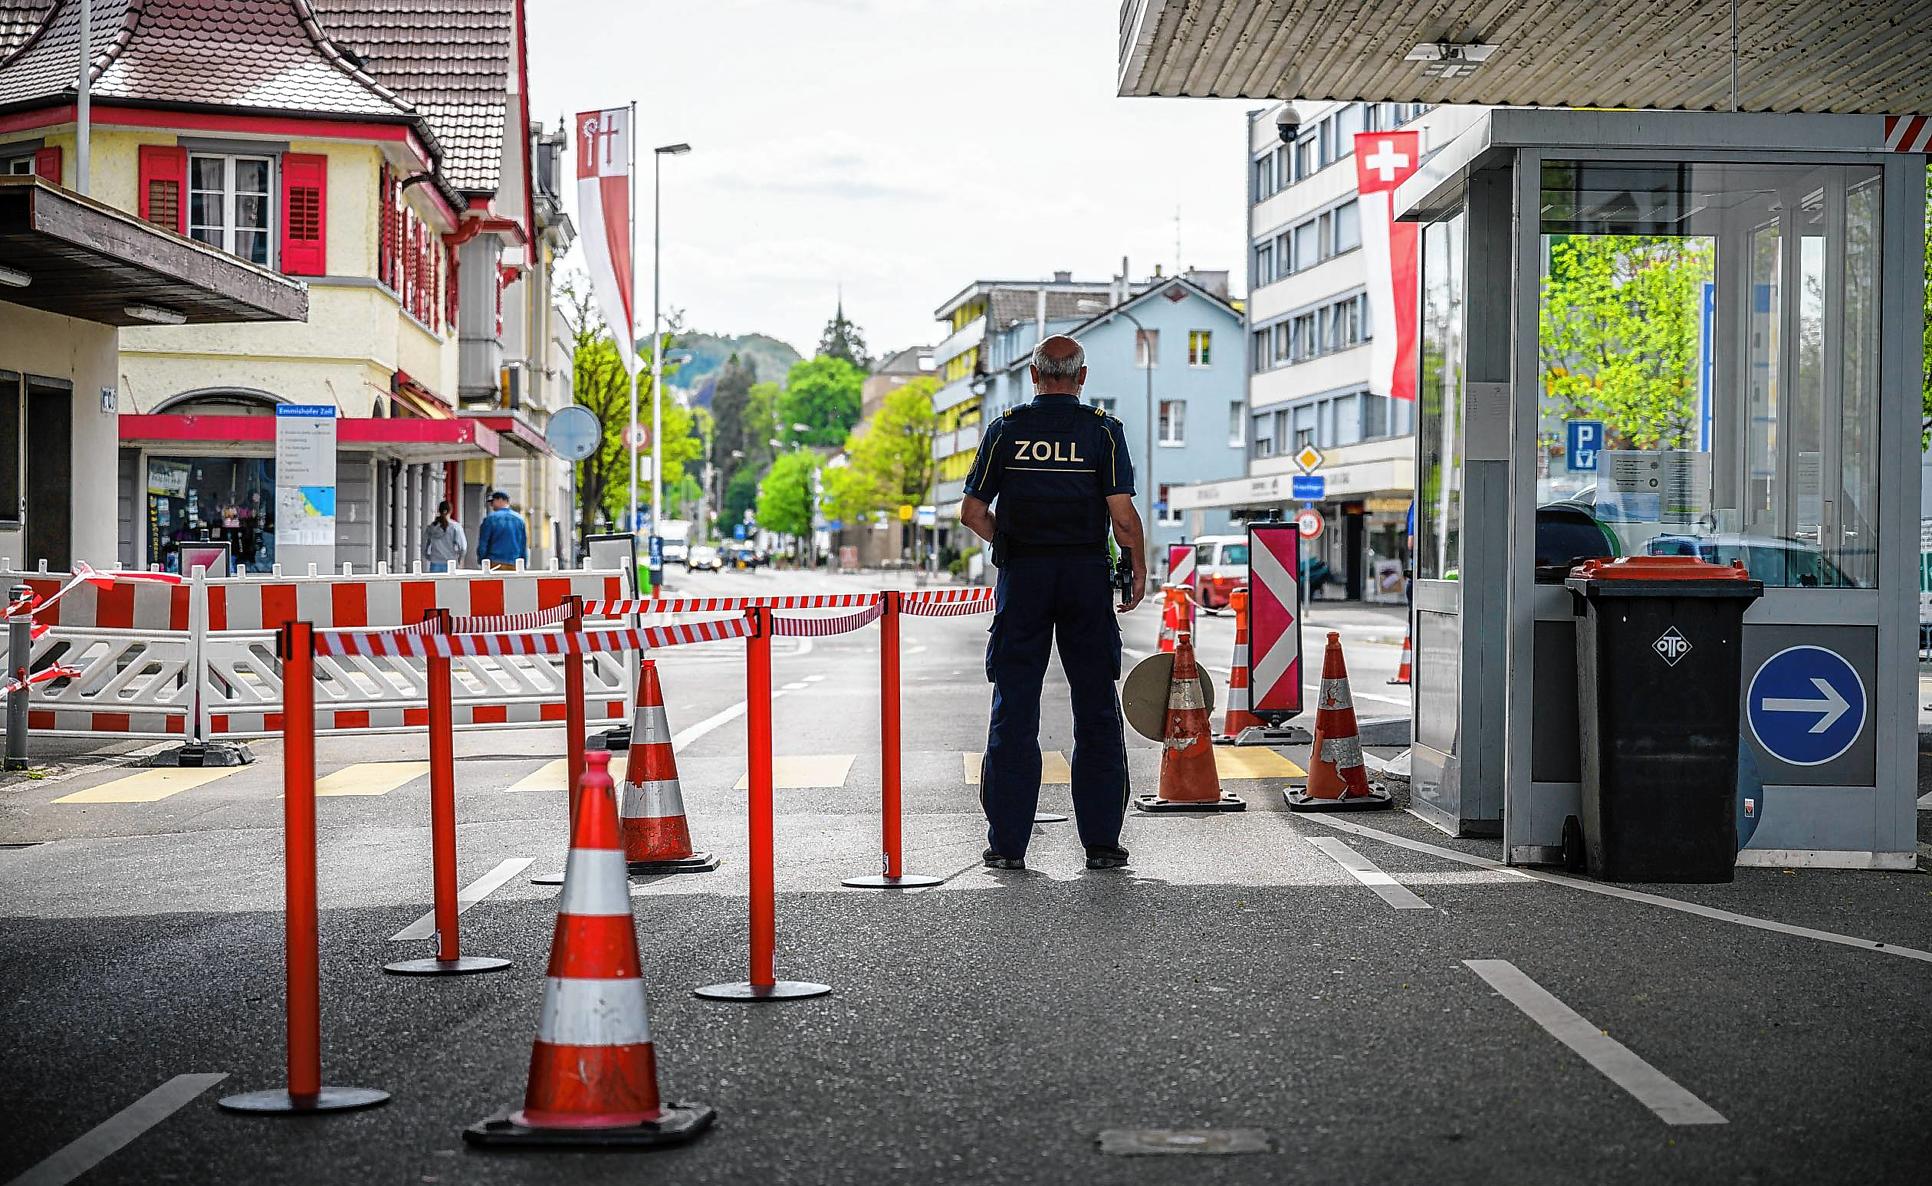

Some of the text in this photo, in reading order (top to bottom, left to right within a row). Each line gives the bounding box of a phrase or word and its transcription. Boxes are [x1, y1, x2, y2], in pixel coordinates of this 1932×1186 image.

[278, 406, 334, 415] Emmishofer Zoll
[1577, 425, 1594, 449] P
[1014, 440, 1084, 462] ZOLL
[1656, 636, 1687, 657] OTTO
